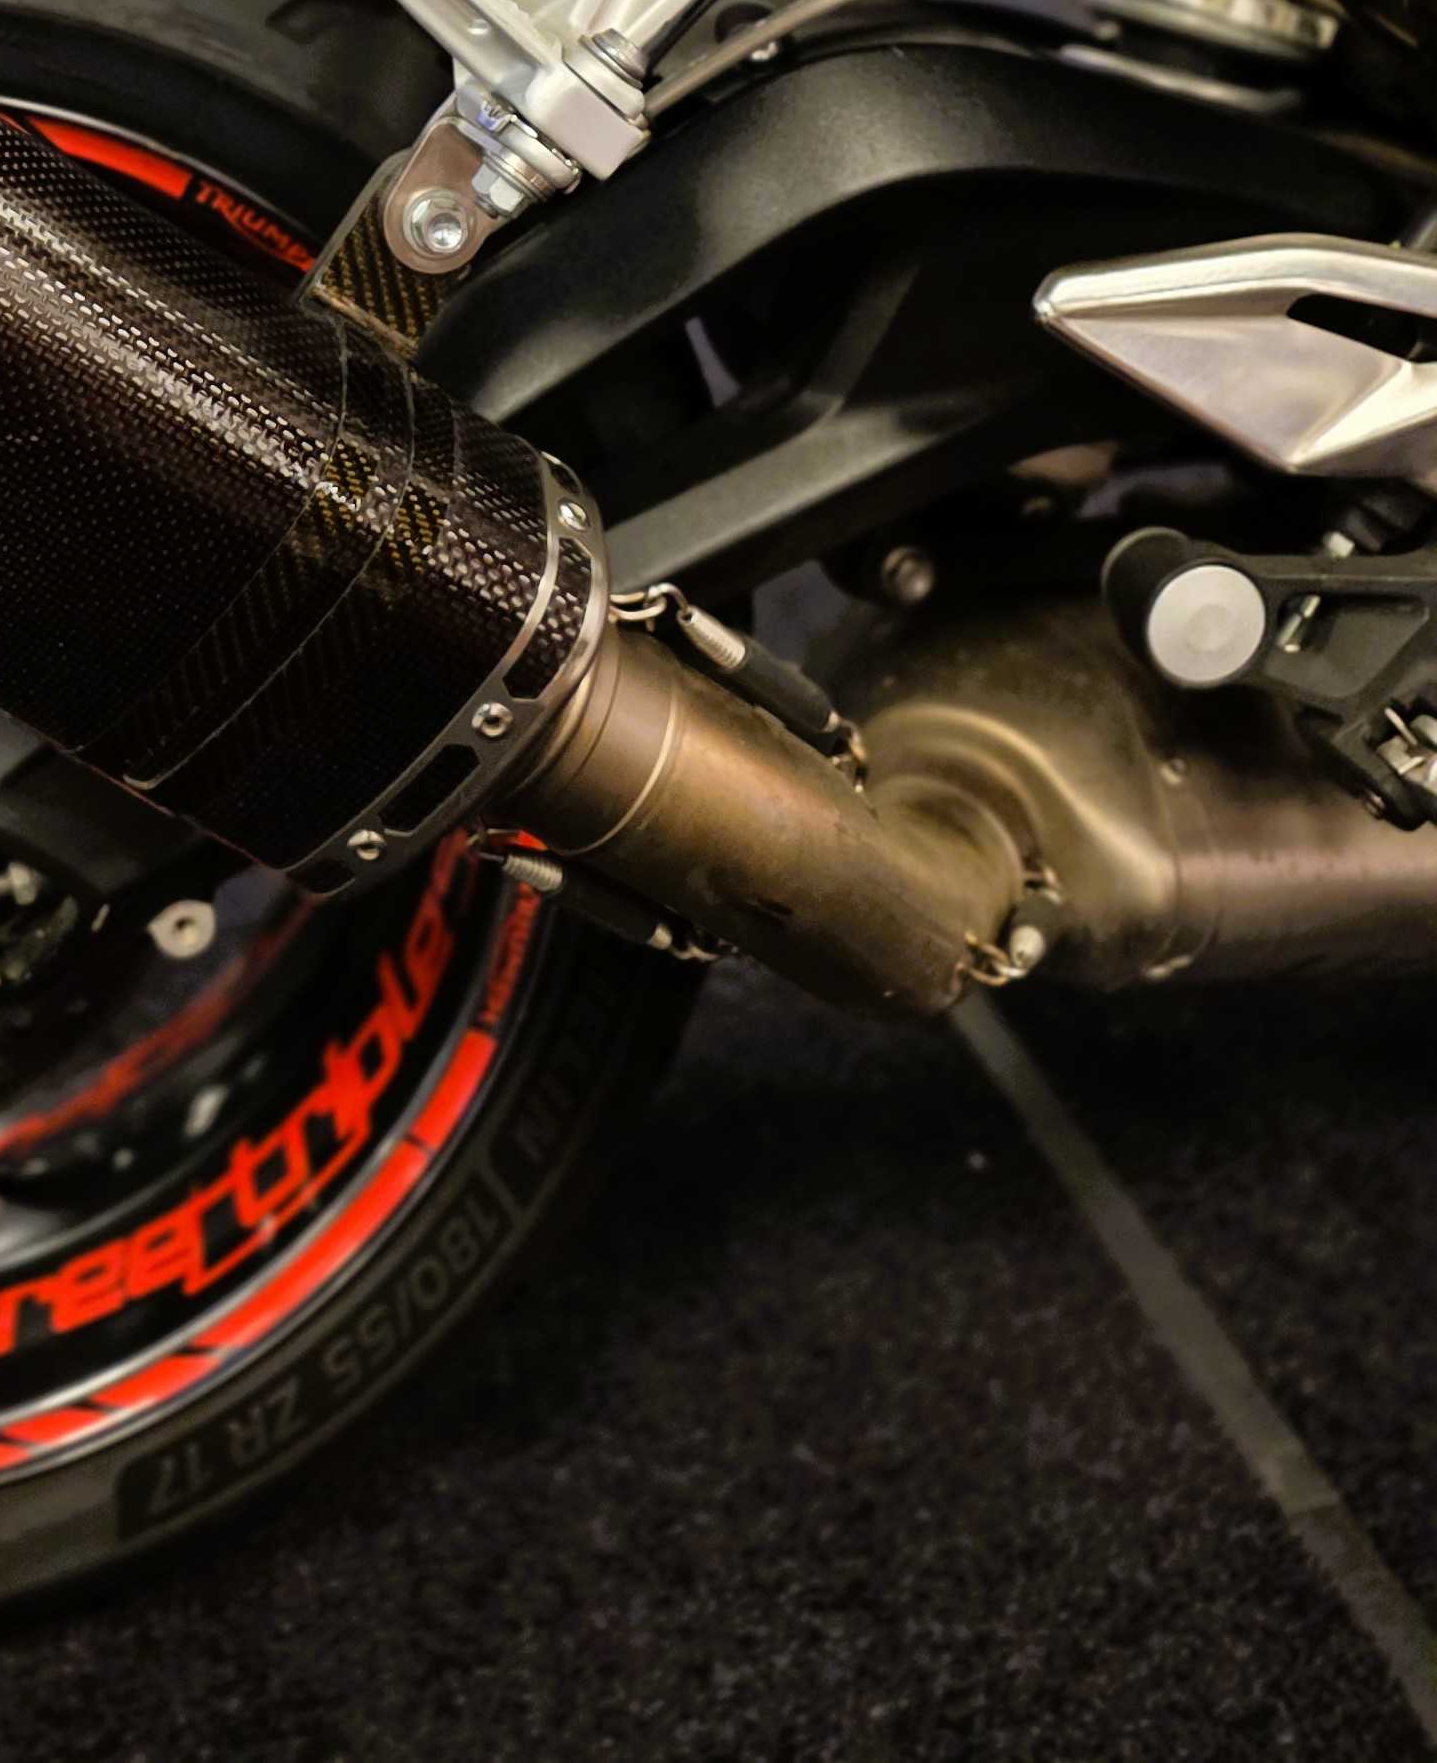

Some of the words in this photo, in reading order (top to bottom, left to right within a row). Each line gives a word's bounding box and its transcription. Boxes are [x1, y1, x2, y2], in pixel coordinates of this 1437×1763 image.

[194, 180, 316, 274] TRIUMP
[326, 1192, 501, 1396] 180/55
[230, 1377, 306, 1451] ZR
